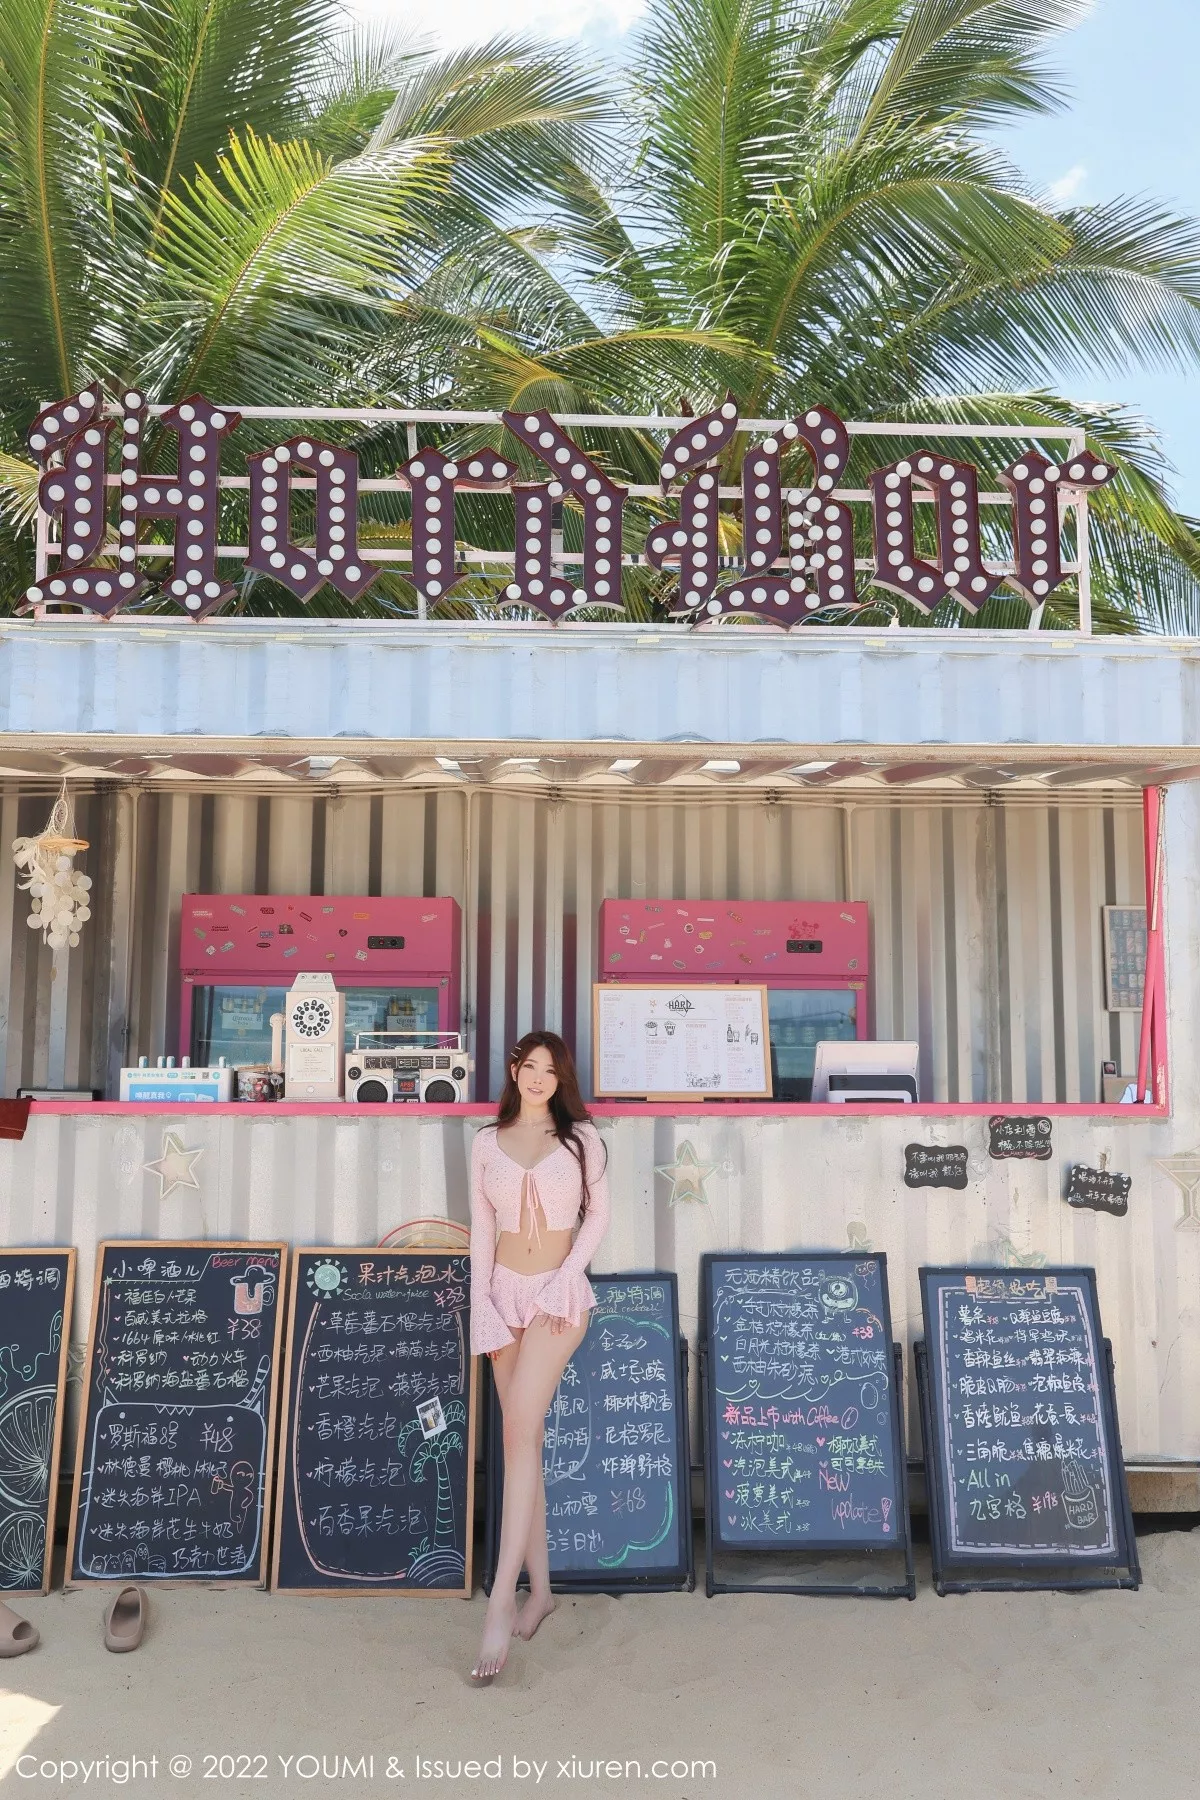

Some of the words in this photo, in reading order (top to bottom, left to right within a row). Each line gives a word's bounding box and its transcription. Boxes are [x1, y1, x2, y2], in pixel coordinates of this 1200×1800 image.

[668, 999, 693, 1012] HARD
[112, 1257, 200, 1279] 小啤酒儿
[211, 1254, 239, 1269] Beer
[342, 1288, 373, 1301] Soda
[117, 1348, 168, 1368] 科罗纳
[190, 1347, 248, 1368] 动力火车
[834, 1345, 887, 1370] 港式奶茶
[600, 1358, 667, 1384] 威士忌酸
[603, 1389, 673, 1414] 椰林飘香
[722, 1403, 781, 1430] 新品上市
[782, 1410, 806, 1426] with
[806, 1405, 840, 1429] Coffee
[605, 1421, 671, 1446] 尼格罗尼
[601, 1452, 673, 1480] 炸弹野格
[831, 1456, 888, 1477] 可可拿铁
[967, 1468, 991, 1491] All
[994, 1472, 1011, 1487] in
[969, 1491, 1027, 1521] 九宫格
[1068, 1501, 1094, 1515] HARD
[740, 1510, 792, 1535] 冰美式
[1077, 1512, 1095, 1524] BAR
